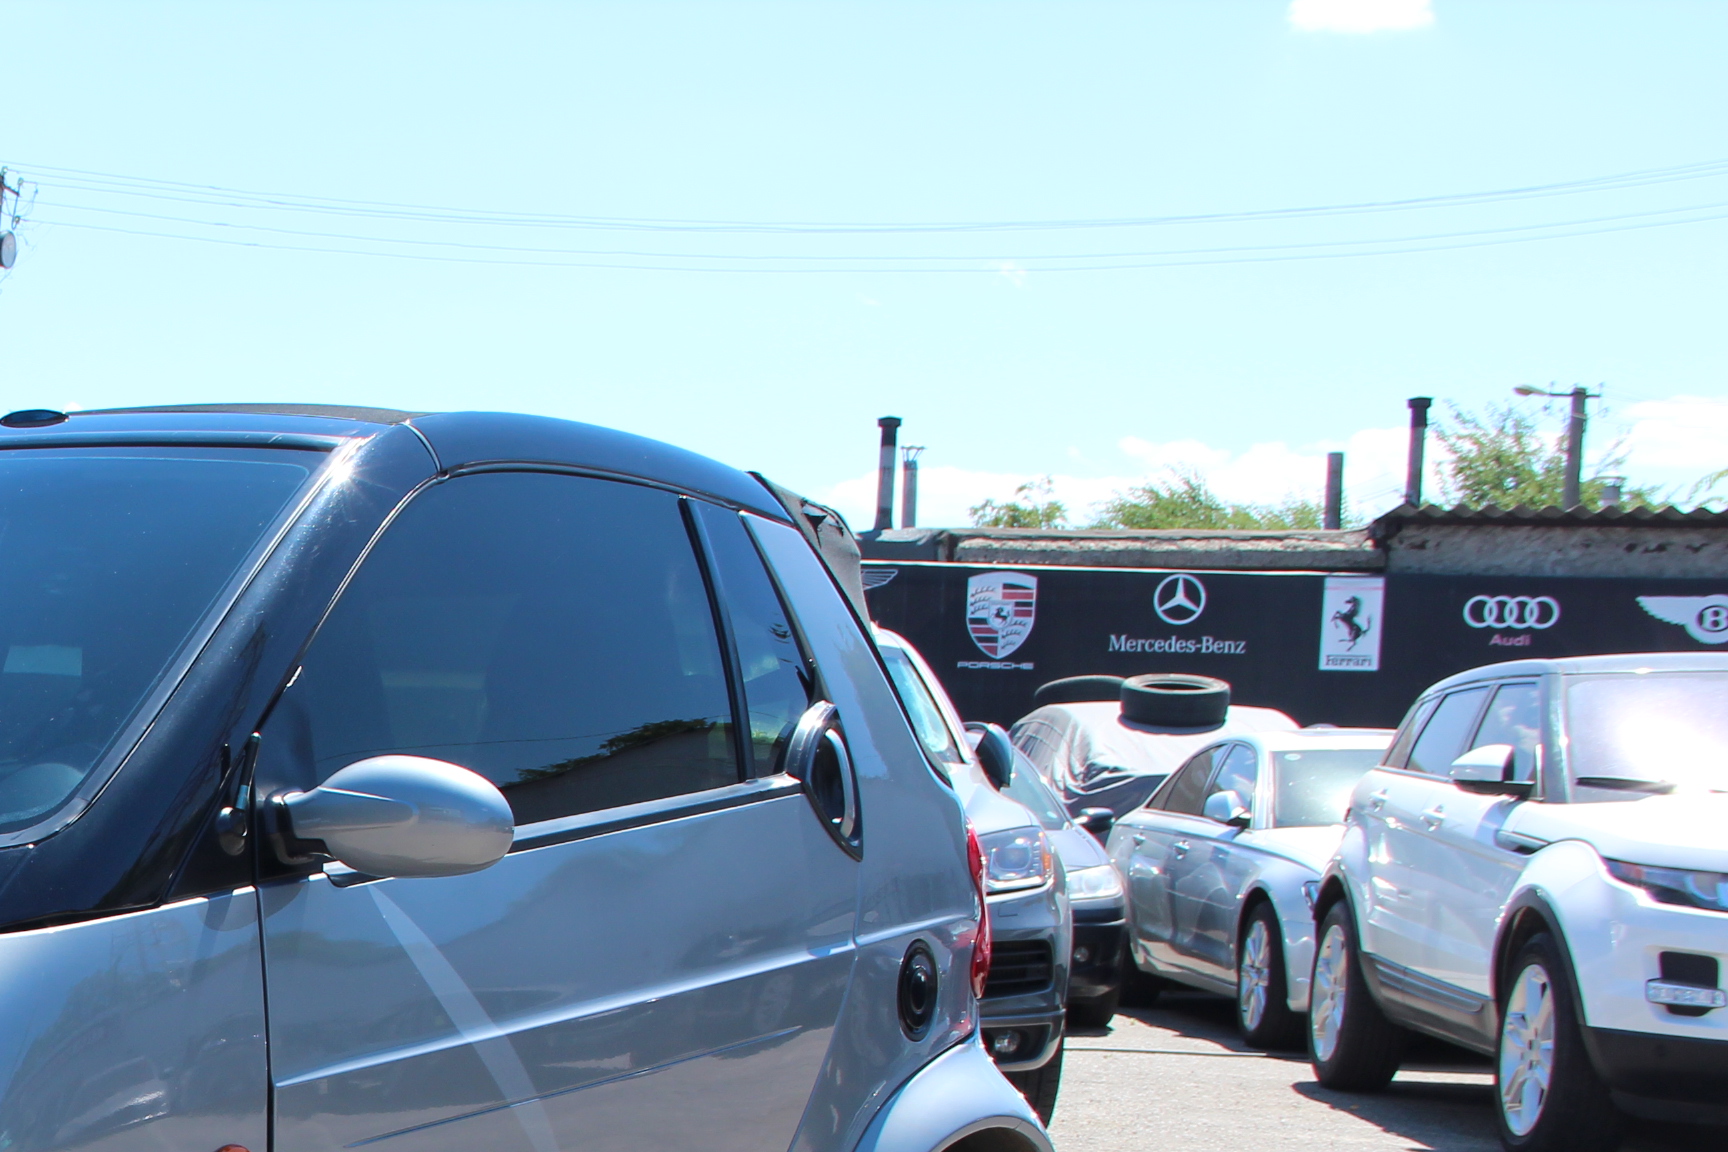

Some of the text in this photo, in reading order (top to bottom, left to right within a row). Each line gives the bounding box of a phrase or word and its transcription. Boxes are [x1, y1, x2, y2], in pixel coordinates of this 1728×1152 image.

[1107, 634, 1247, 655] Mercedes-Benz
[1488, 633, 1532, 646] Audi
[956, 660, 1035, 670] PORSCHE
[1325, 654, 1372, 667] Ferrari
